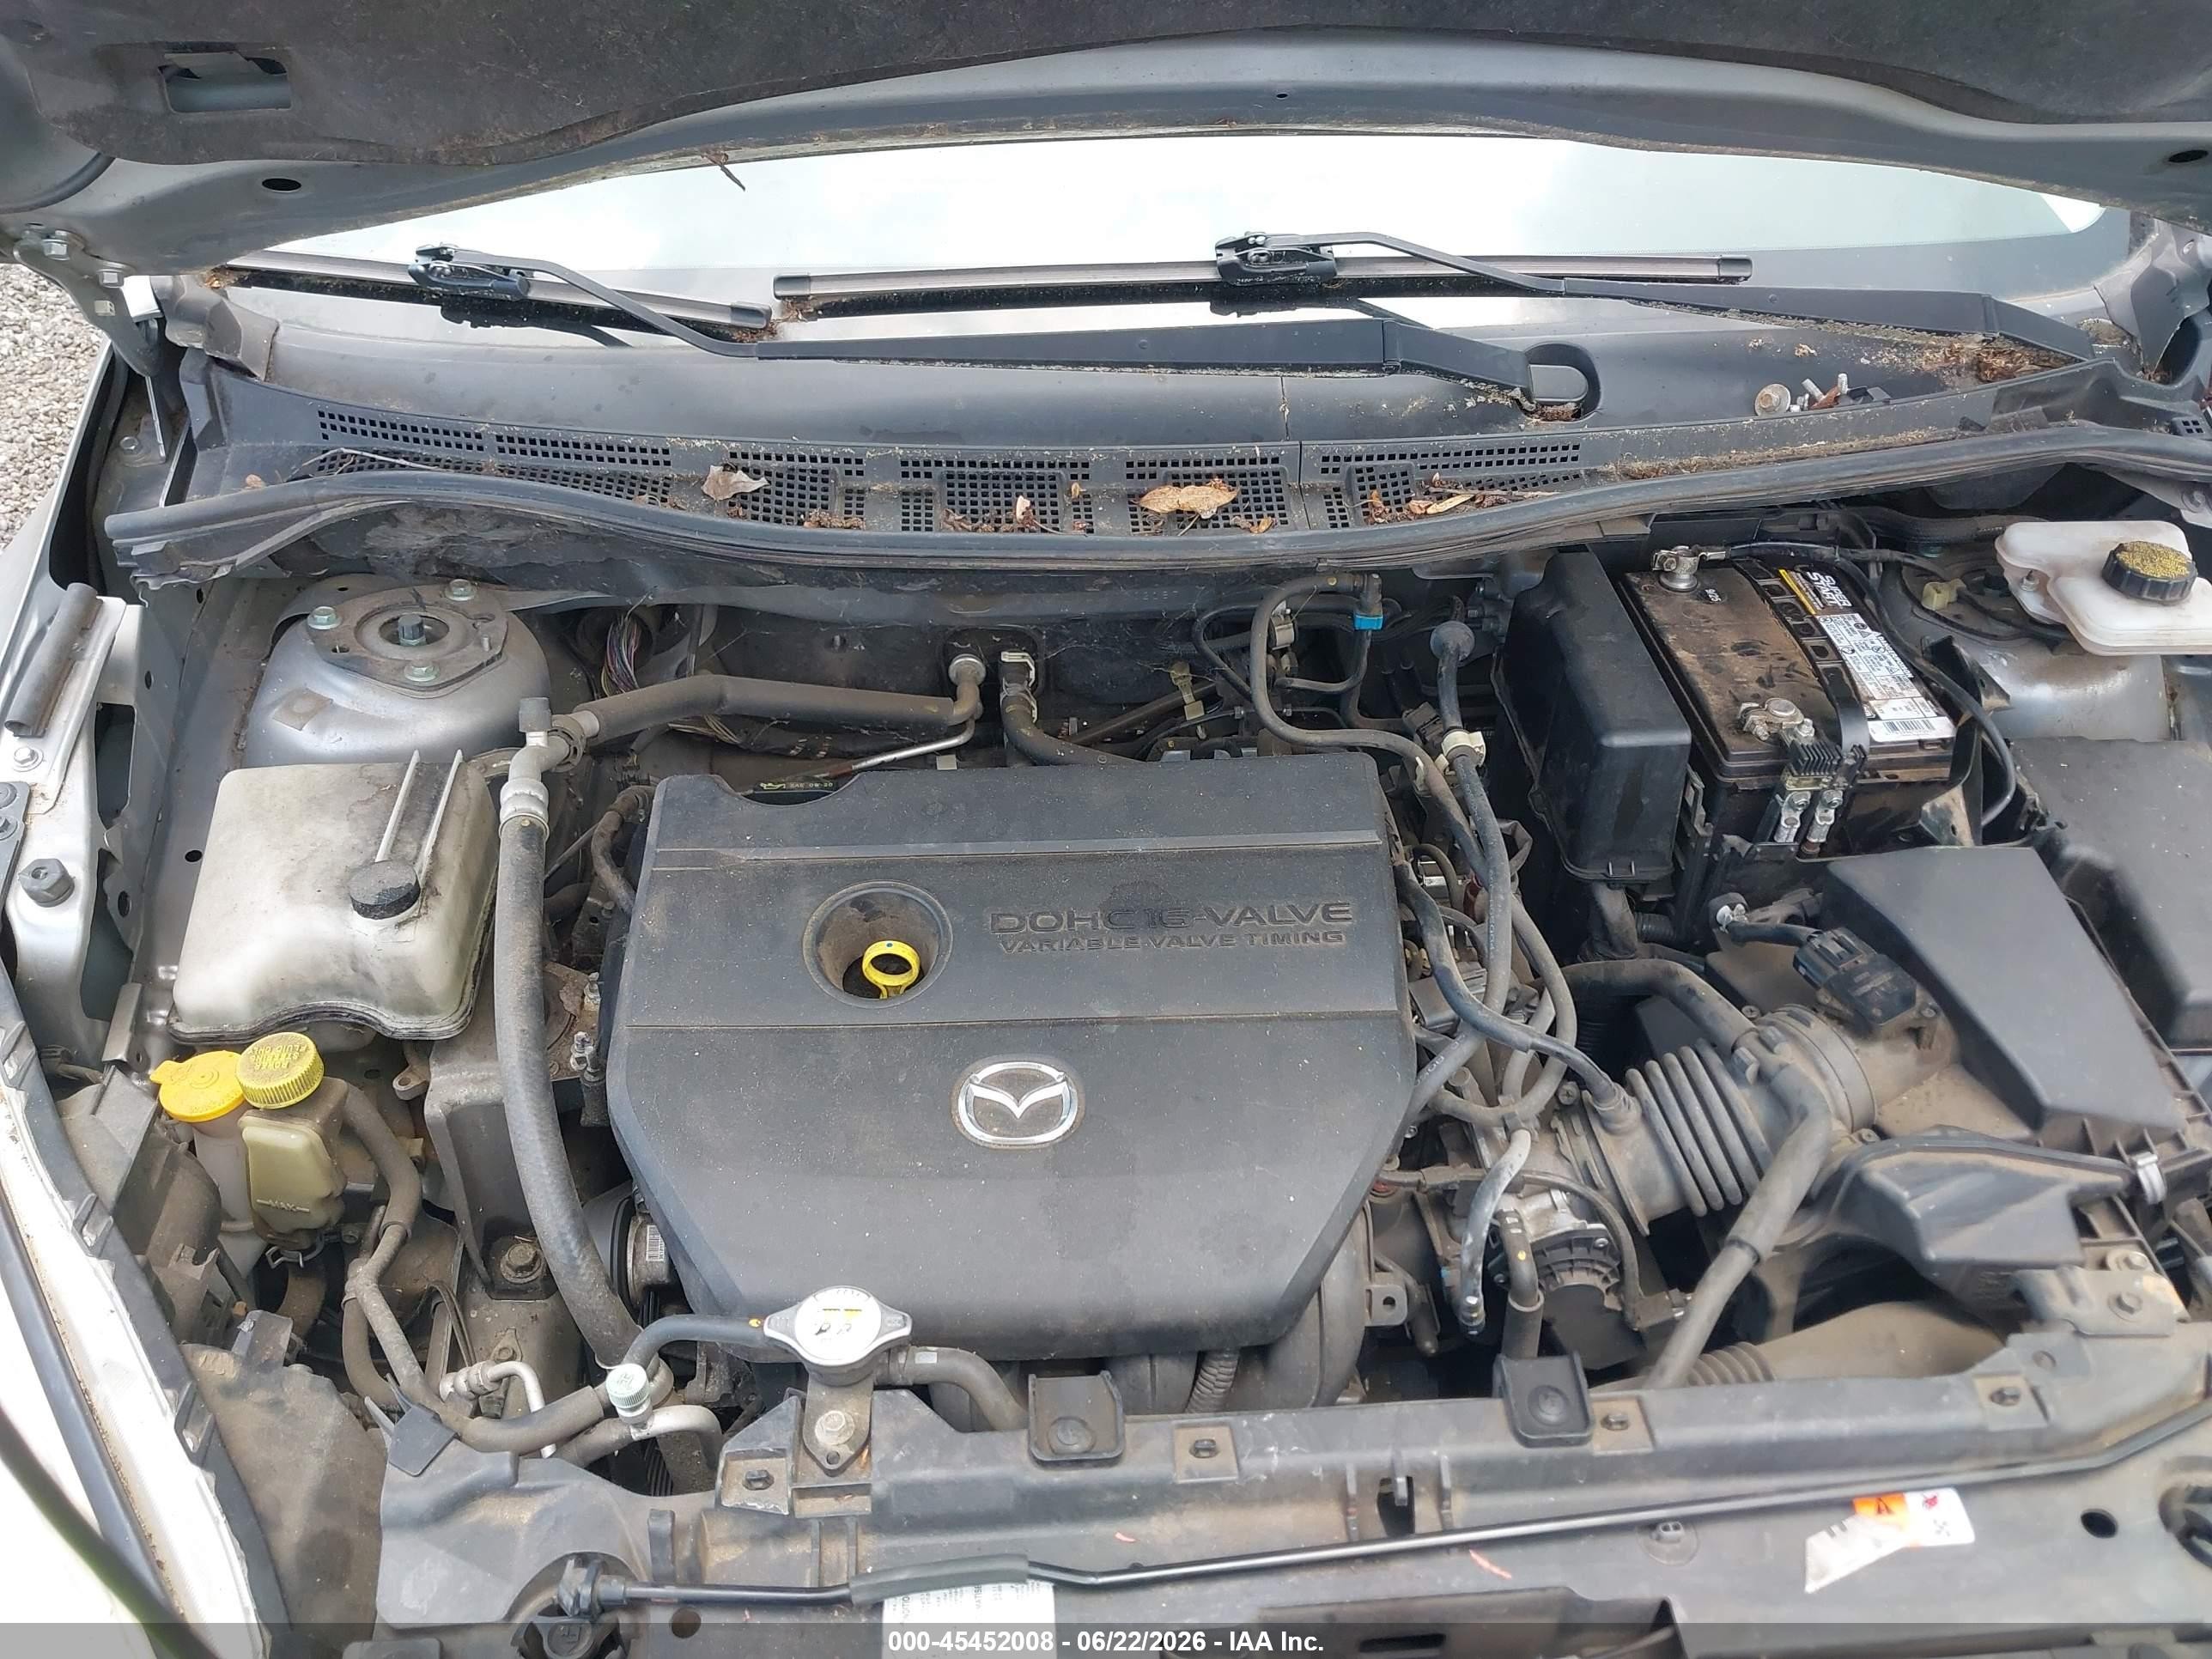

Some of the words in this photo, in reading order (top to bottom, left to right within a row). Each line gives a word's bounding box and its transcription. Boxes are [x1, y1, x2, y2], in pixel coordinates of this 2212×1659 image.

[1806, 571, 1843, 607] START
[1824, 575, 1852, 607] SUPER
[989, 908, 1136, 935] DOHC
[1146, 902, 1354, 931] 16-VALVE
[1001, 935, 1140, 954] VARIABLE
[1147, 933, 1237, 950] VALVE
[1248, 929, 1346, 946] TIMING
[275, 1044, 308, 1053] FLUID
